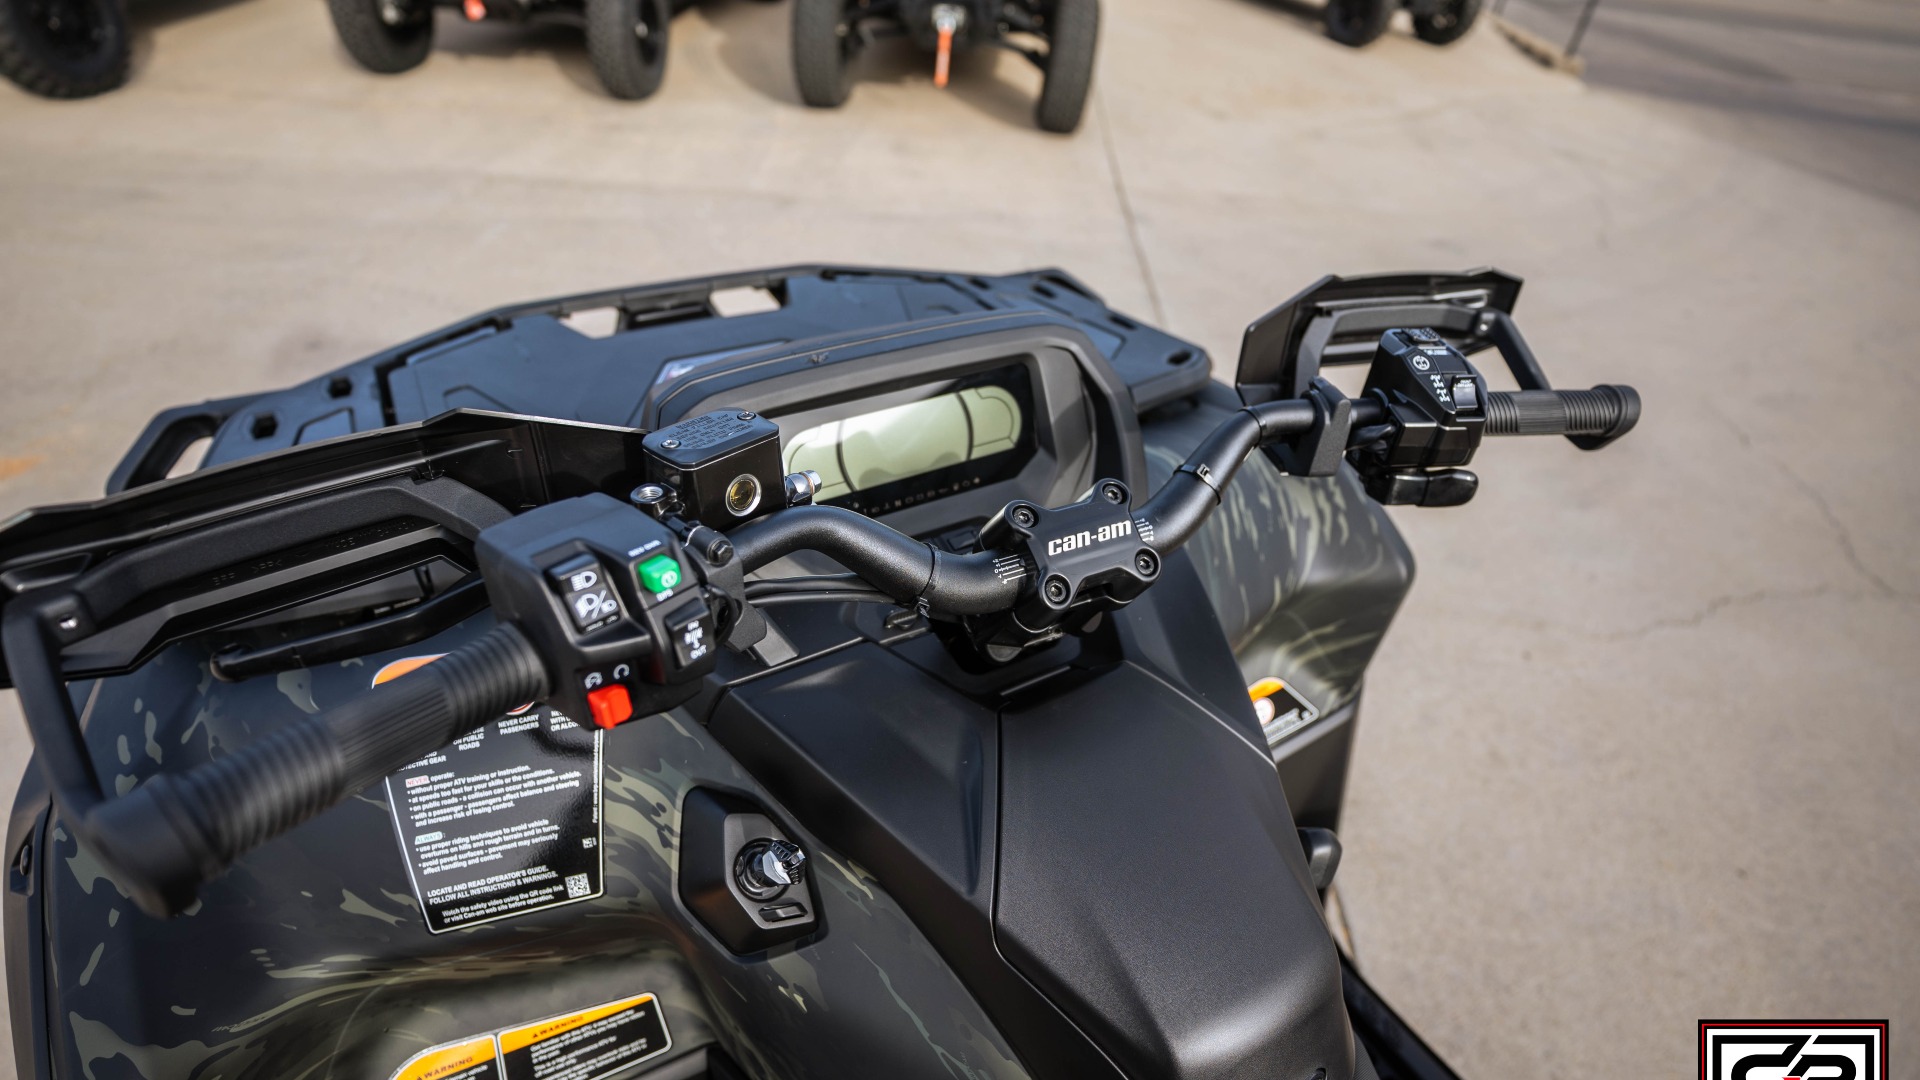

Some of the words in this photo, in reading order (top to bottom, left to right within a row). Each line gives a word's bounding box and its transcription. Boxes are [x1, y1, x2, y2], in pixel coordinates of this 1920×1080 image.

[1048, 520, 1131, 556] can-am
[498, 718, 518, 729] NEVER
[518, 714, 540, 724] CARRY
[500, 722, 540, 735] PASSENGERS
[458, 741, 480, 751] ROADS
[463, 733, 484, 744] PUBLIC
[429, 756, 446, 765] GEAR
[411, 784, 432, 795] without
[434, 781, 453, 792] proper
[454, 777, 466, 786] ATV
[467, 773, 489, 783] training
[419, 792, 440, 803] speeds
[452, 787, 463, 795] fast
[474, 783, 487, 791] your
[488, 779, 504, 787] skills
[422, 800, 440, 811] public
[441, 797, 458, 806] roads
[468, 790, 492, 800] collision
[505, 784, 522, 792] occur
[536, 776, 559, 785] another
[414, 811, 427, 820] with
[433, 804, 463, 816] passenger
[468, 797, 502, 809] passengers
[502, 792, 519, 801] affect
[520, 788, 543, 797] balance
[544, 784, 555, 792] and
[555, 780, 579, 790] steering
[415, 819, 427, 827] and
[428, 815, 452, 825] increase
[473, 806, 492, 815] losing
[421, 849, 449, 859] overturns
[459, 843, 472, 851] hills
[473, 840, 484, 848] and
[485, 836, 502, 845] rough
[503, 832, 523, 841] terrain
[432, 841, 451, 850] proper
[452, 836, 470, 845] riding
[470, 829, 502, 841] techniques
[511, 823, 527, 832] avoid
[528, 819, 549, 828] vehicle
[422, 860, 438, 868] avoid
[440, 855, 458, 865] paved
[458, 850, 484, 860] surfaces
[488, 843, 517, 854] pavement
[531, 833, 558, 844] seriously
[423, 866, 440, 875] affect
[441, 860, 467, 871] handling
[468, 857, 479, 866] and
[427, 886, 453, 897] LOCATE
[454, 883, 467, 892] AND
[468, 878, 486, 888] READ
[487, 868, 526, 884] OPERATOR'S
[429, 894, 456, 905] FOLLOW
[457, 891, 470, 899] ALL
[470, 881, 516, 897] INSTRUCTIONS
[442, 908, 460, 917] Watch
[470, 902, 487, 911] safety
[488, 898, 503, 906] video
[504, 894, 519, 903] using
[424, 1056, 473, 1079] WARNING
